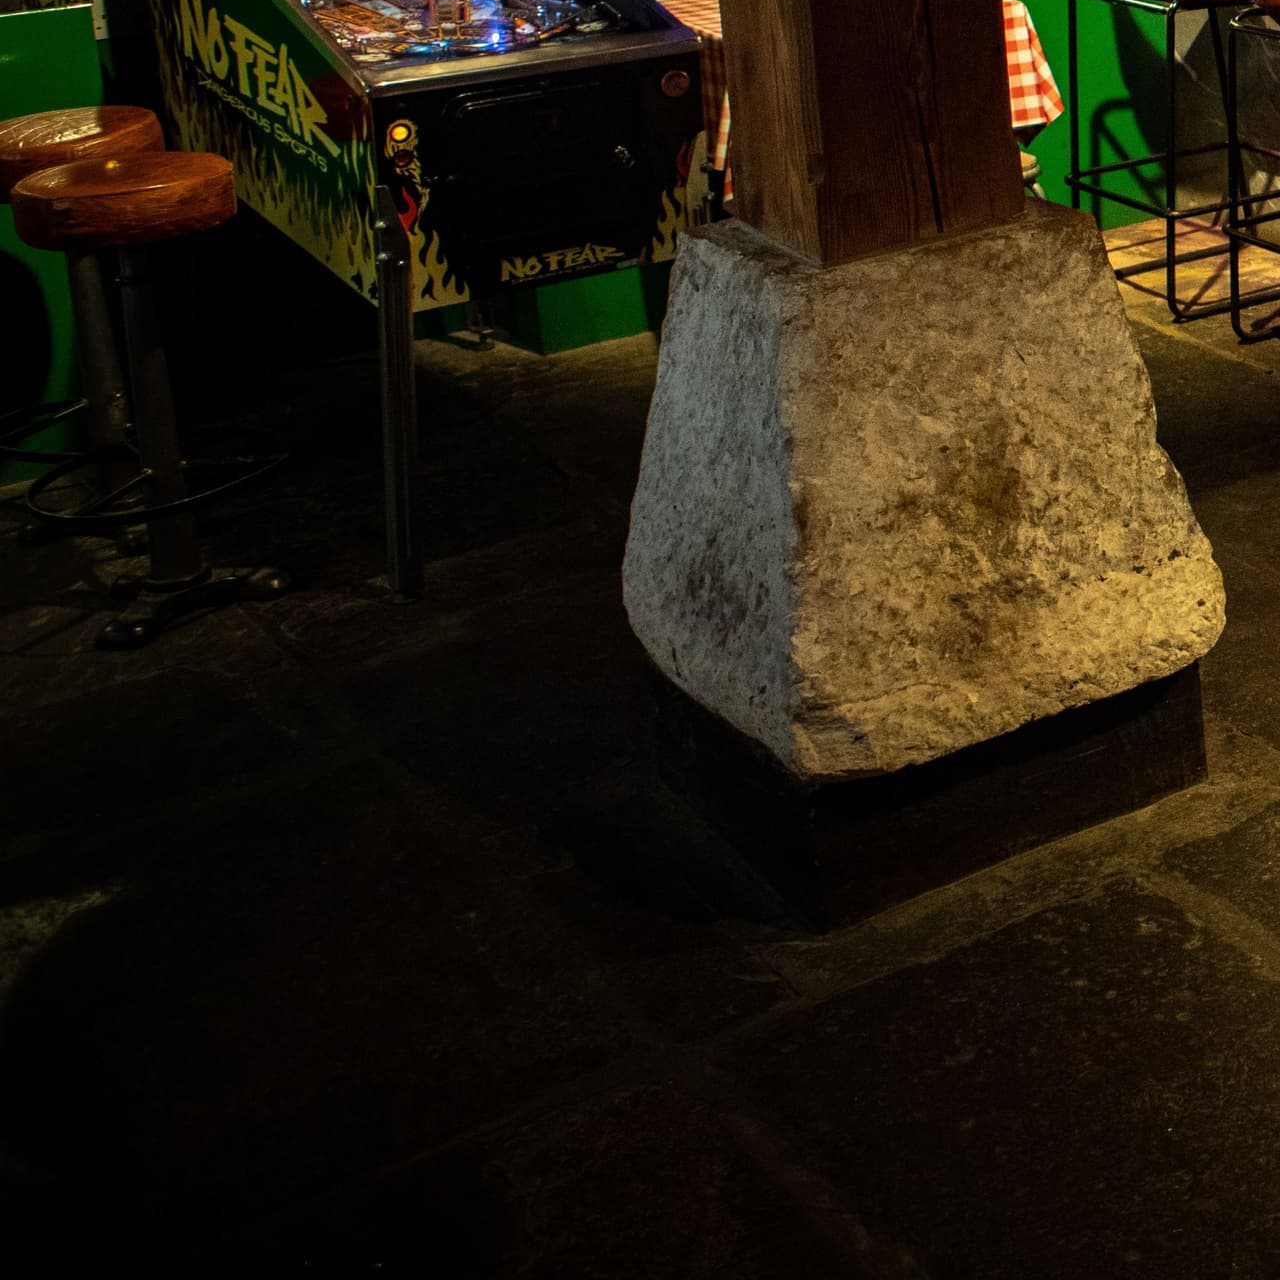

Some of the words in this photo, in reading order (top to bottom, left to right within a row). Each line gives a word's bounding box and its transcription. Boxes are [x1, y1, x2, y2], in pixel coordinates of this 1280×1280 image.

[223, 13, 342, 159] FEAR
[500, 255, 544, 283] NO
[542, 241, 625, 271] FEAR
